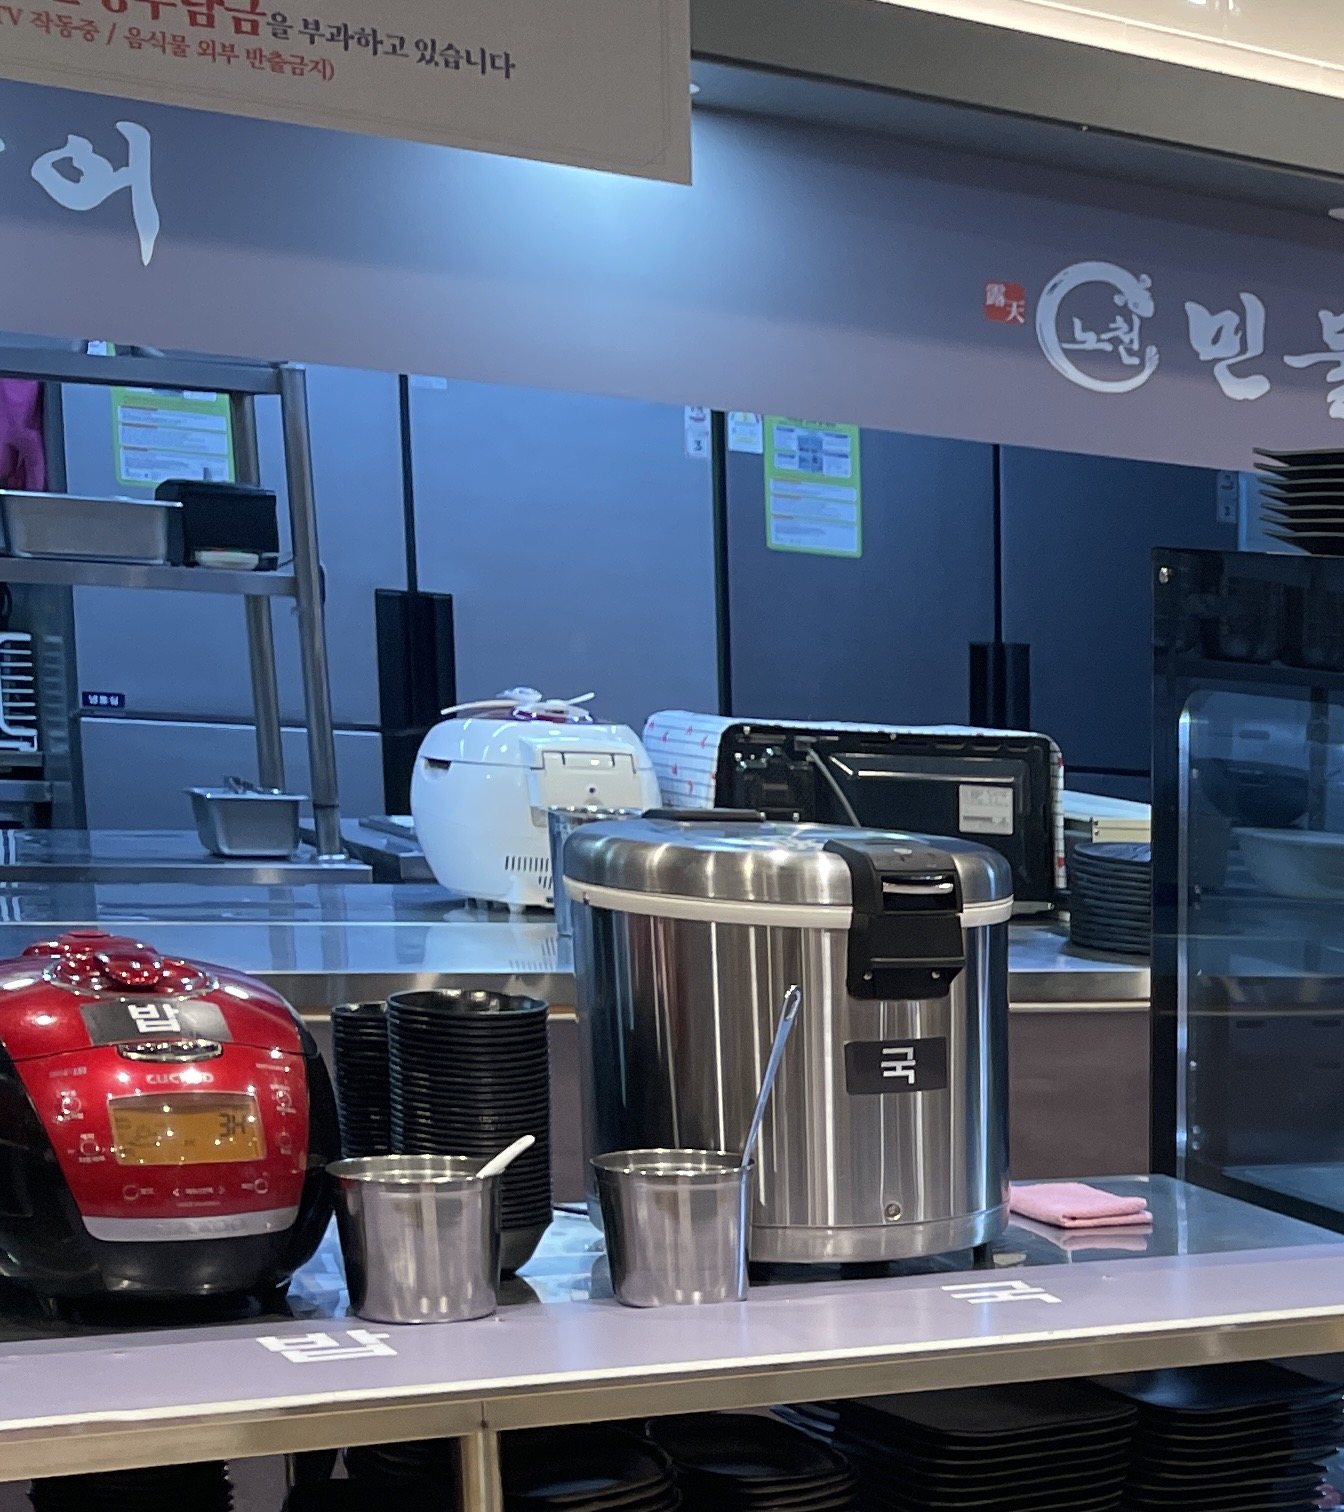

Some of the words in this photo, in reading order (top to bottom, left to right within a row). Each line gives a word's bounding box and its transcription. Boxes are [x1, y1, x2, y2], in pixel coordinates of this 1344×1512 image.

[30, 10, 100, 42] 작동중
[123, 26, 190, 59] 음식물
[197, 38, 240, 67] 외부
[245, 48, 336, 81] 반출금지)
[299, 18, 410, 59] 부과하고
[414, 38, 516, 79] 있습니다
[0, 120, 160, 267] 어
[127, 1001, 181, 1034] 밥
[880, 1046, 918, 1085] 국
